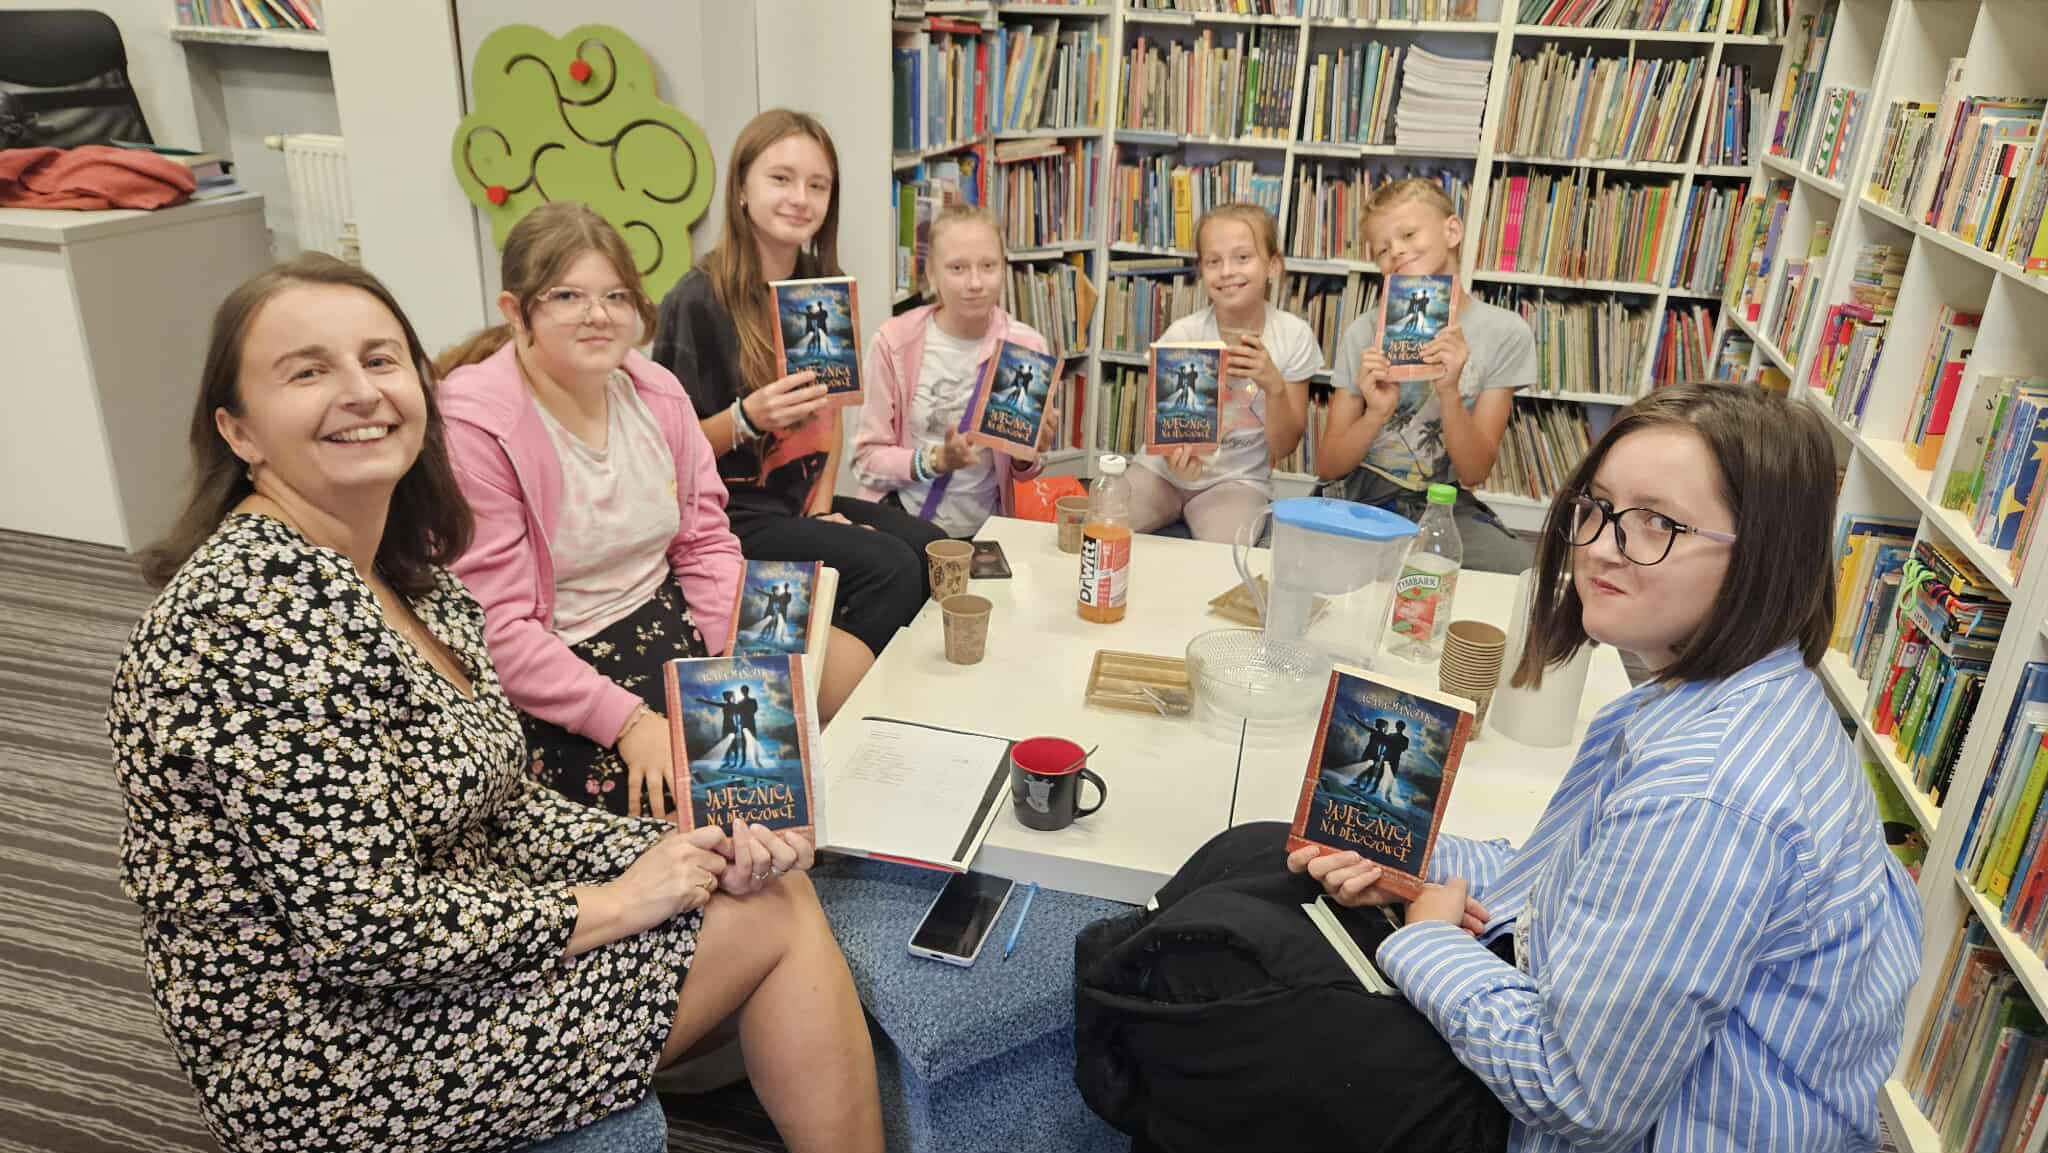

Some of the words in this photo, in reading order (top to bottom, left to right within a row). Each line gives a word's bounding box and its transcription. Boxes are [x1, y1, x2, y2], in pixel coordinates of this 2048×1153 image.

[705, 783, 796, 810] JAJECZNICA
[706, 811, 724, 827] NA
[1319, 818, 1336, 836] NA
[1324, 799, 1413, 849] JAJECZNICA
